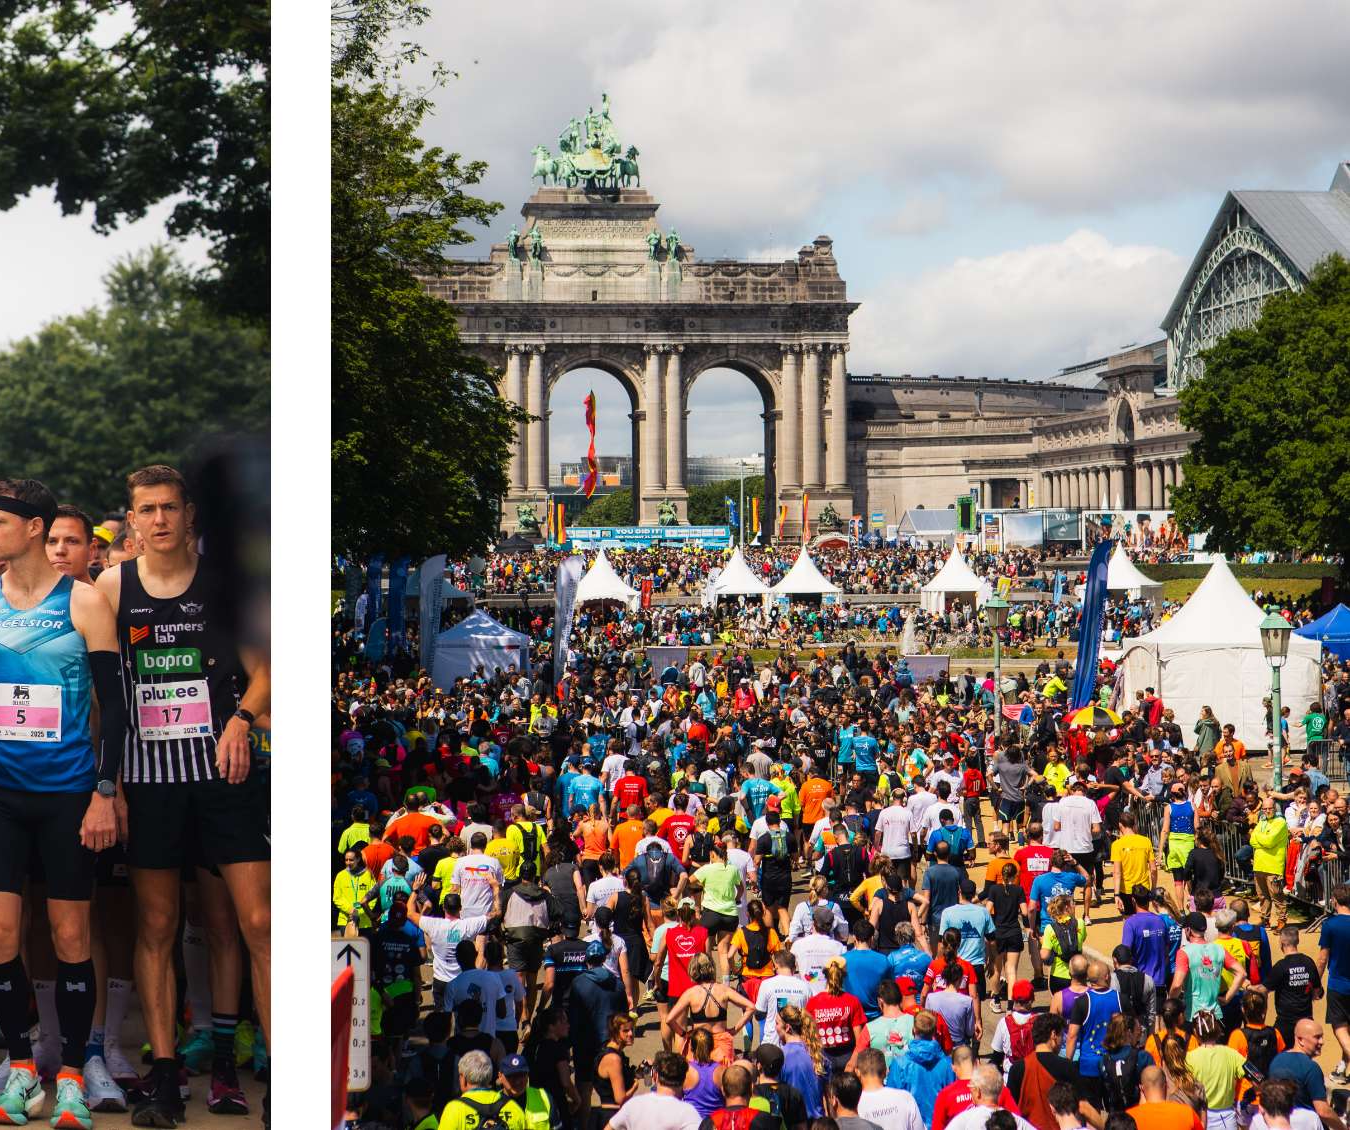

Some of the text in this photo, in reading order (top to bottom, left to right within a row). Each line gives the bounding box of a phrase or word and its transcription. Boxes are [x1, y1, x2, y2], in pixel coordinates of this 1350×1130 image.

[1056, 513, 1070, 521] VIP
[155, 633, 176, 644] lab
[143, 651, 194, 670] bopro
[142, 686, 199, 704] pluxee
[16, 709, 26, 724] 5
[161, 707, 182, 723] 17
[30, 730, 45, 738] 2025
